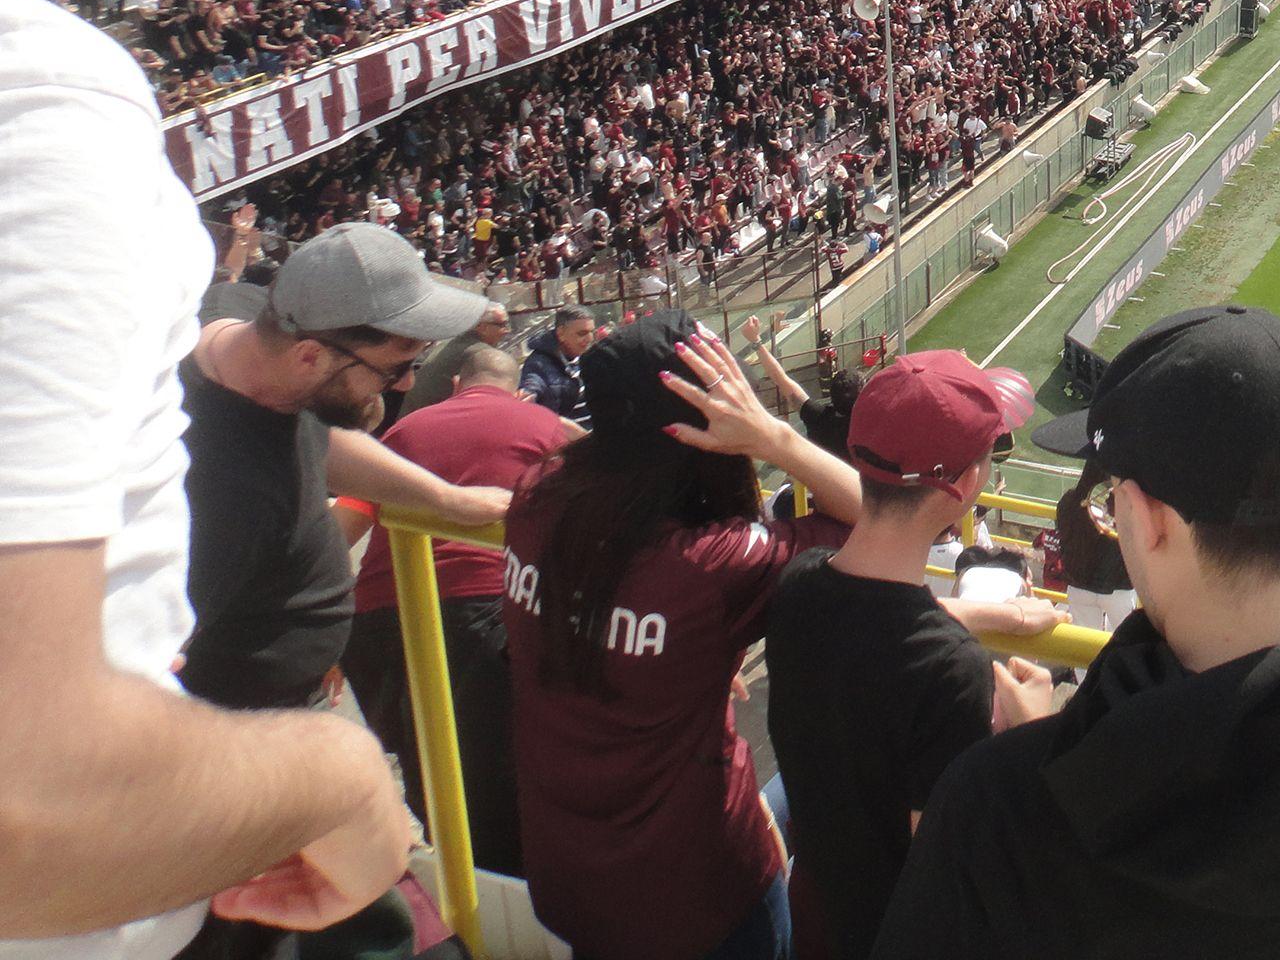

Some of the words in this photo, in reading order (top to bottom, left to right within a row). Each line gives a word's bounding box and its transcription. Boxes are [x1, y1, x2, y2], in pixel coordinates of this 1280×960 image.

[185, 64, 361, 191] NATI
[386, 15, 499, 111] PER
[1230, 130, 1256, 171] Zeus
[1175, 189, 1203, 237] Zeus
[1106, 259, 1143, 315] Zeus
